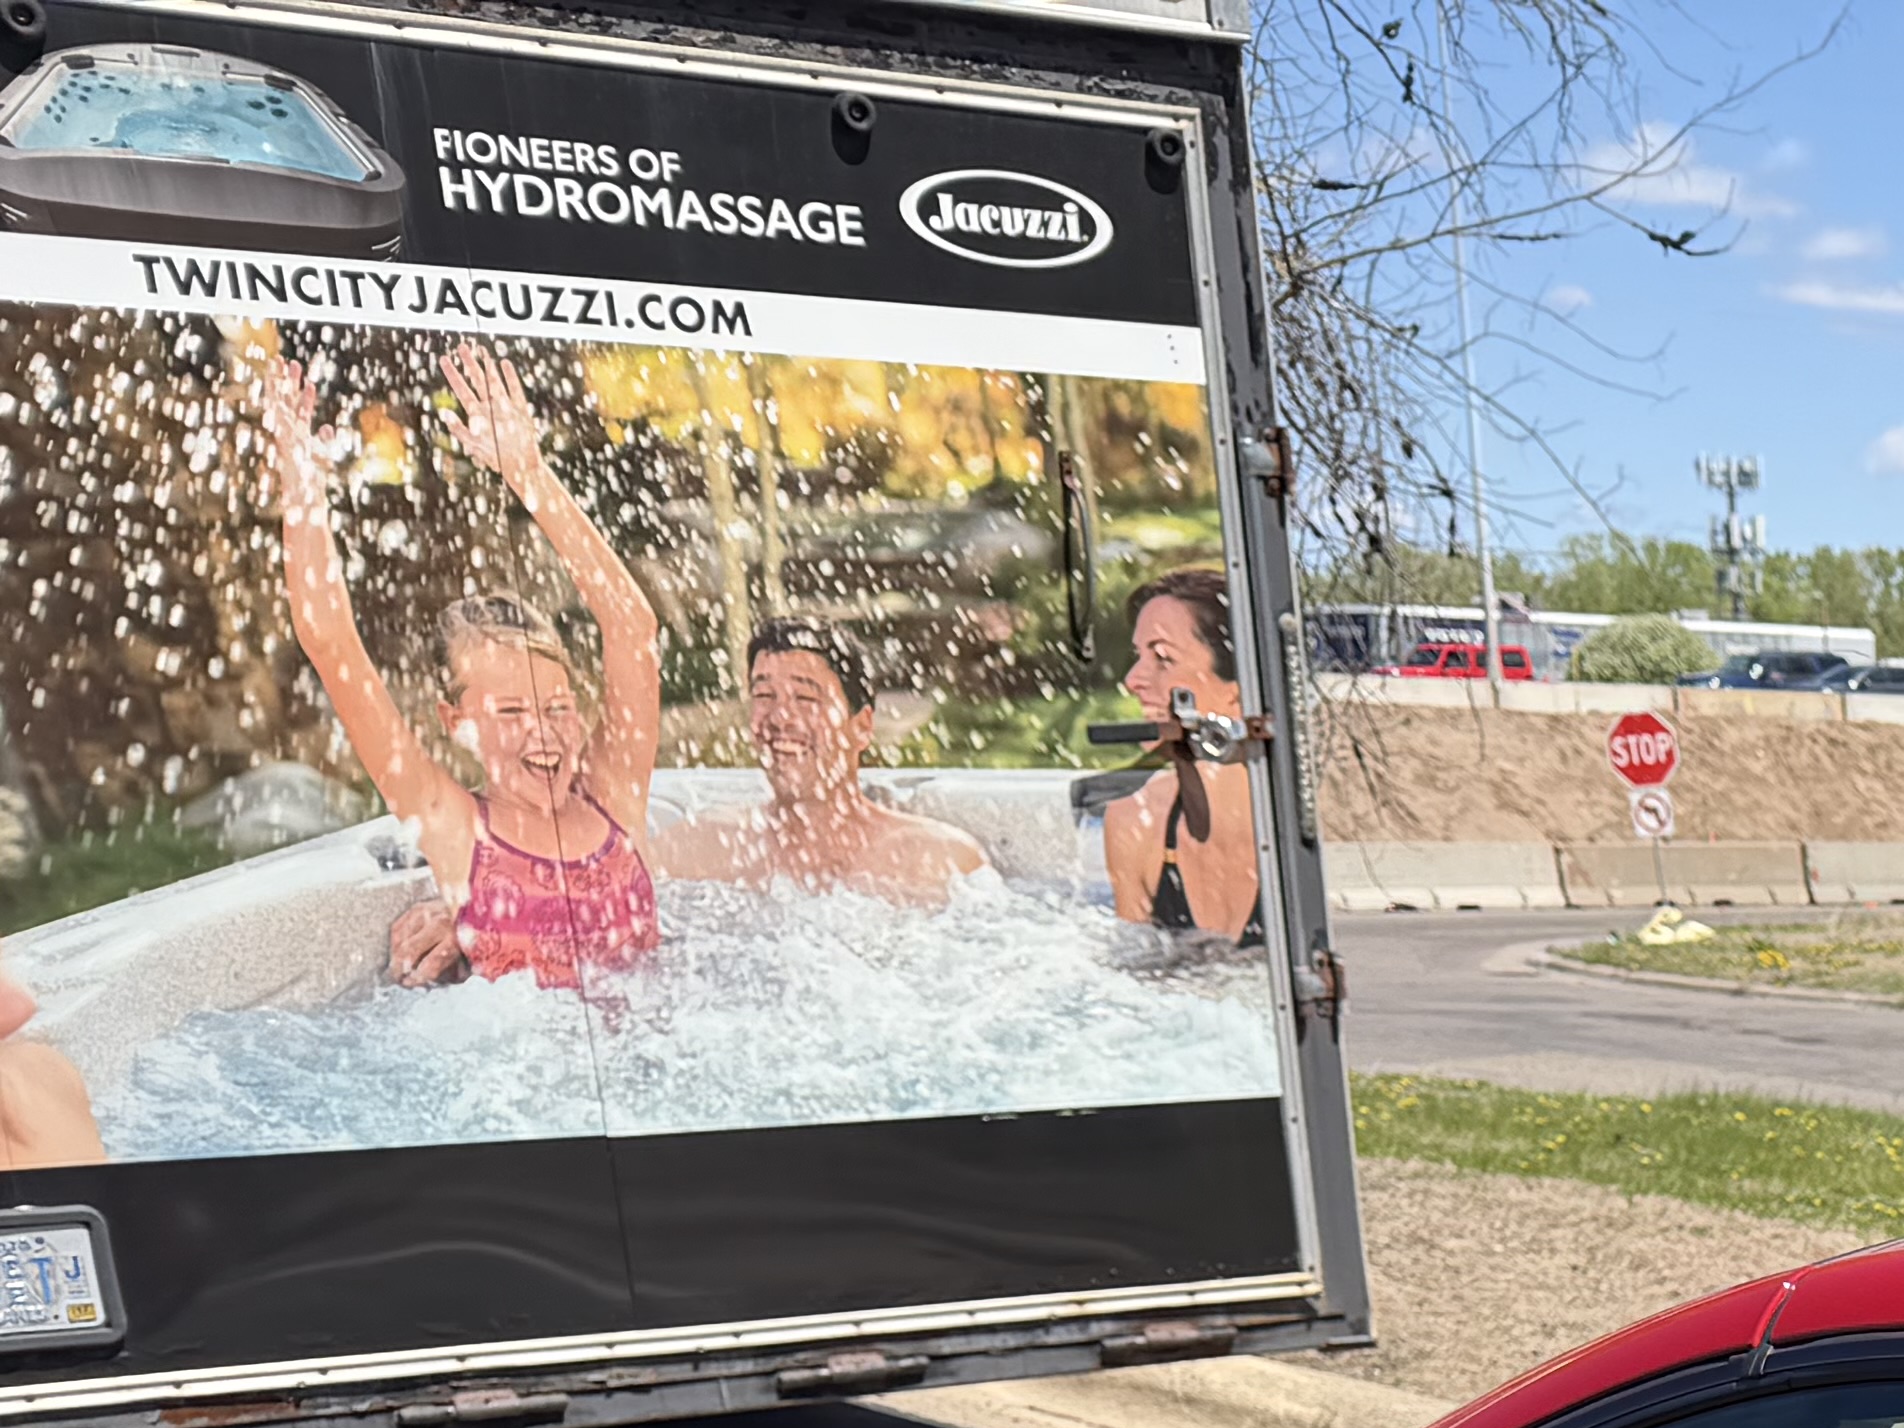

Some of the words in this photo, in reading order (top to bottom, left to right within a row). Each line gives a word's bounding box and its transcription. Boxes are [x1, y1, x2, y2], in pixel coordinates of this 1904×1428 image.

[628, 148, 683, 182] OF
[438, 166, 867, 247] HYDROMASSAGE
[928, 192, 1083, 242] Jacuzzi
[133, 253, 754, 338] TWINCITYJACUZZI.COM
[1611, 732, 1673, 767] STOP
